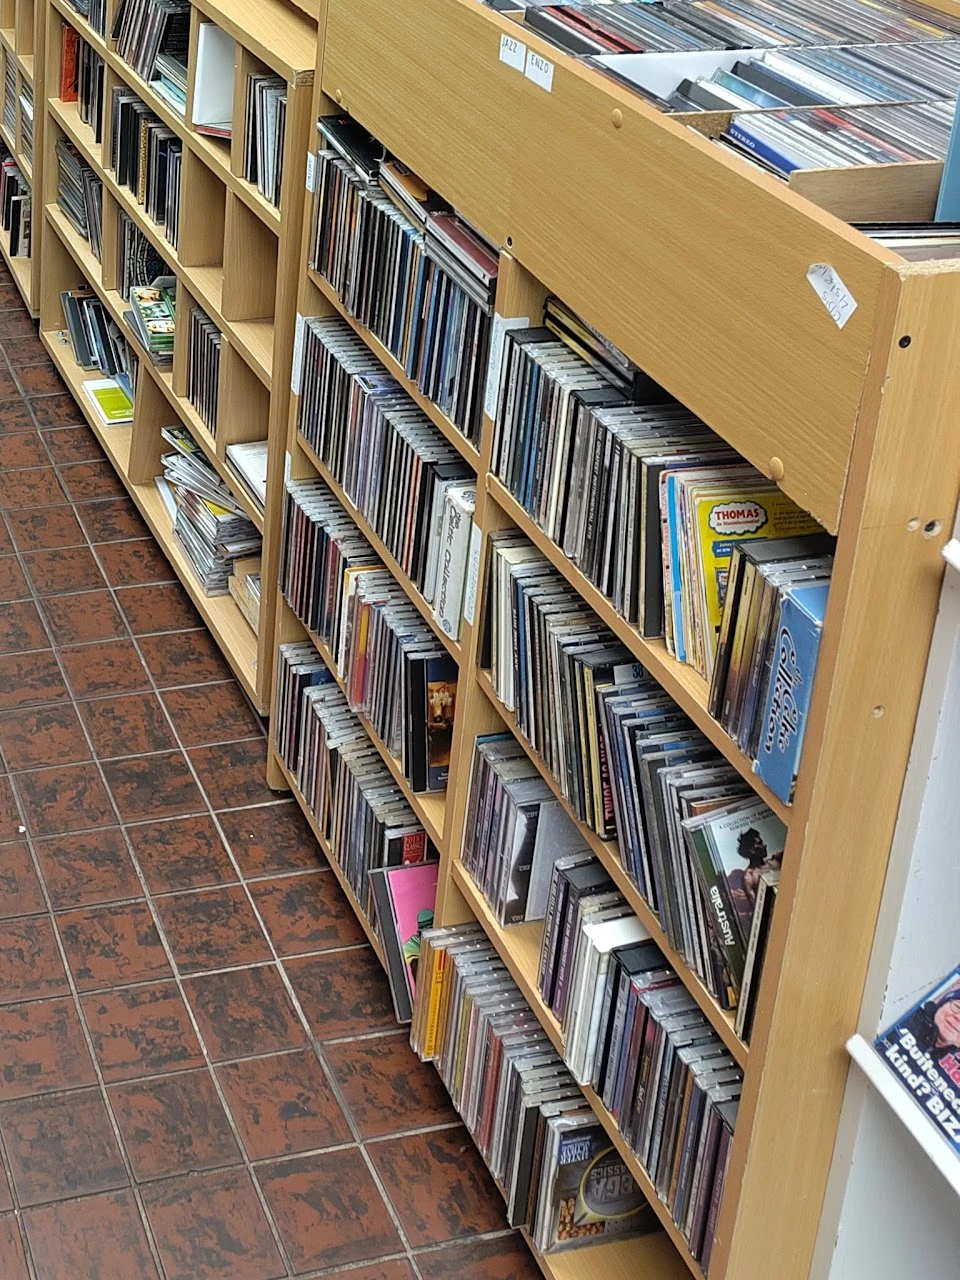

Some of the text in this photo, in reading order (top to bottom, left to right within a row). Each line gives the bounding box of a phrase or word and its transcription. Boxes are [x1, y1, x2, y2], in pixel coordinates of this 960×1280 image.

[502, 36, 518, 54] JAZZ
[530, 54, 548, 74] ENZO
[730, 128, 756, 148] STEREO
[593, 441, 602, 475] GREATEST
[588, 475, 598, 523] INSTRUMENTAL
[714, 508, 760, 520] THOMAS
[440, 505, 456, 618] Celtic Collection
[632, 664, 644, 678] 38
[763, 626, 798, 754] Collection
[778, 688, 800, 753] Celtic
[723, 816, 750, 830] COLLECTION
[730, 821, 749, 832] REMIXED
[710, 884, 735, 946] Australia
[886, 1043, 931, 1096] kind?
[591, 1175, 633, 1203] EGA
